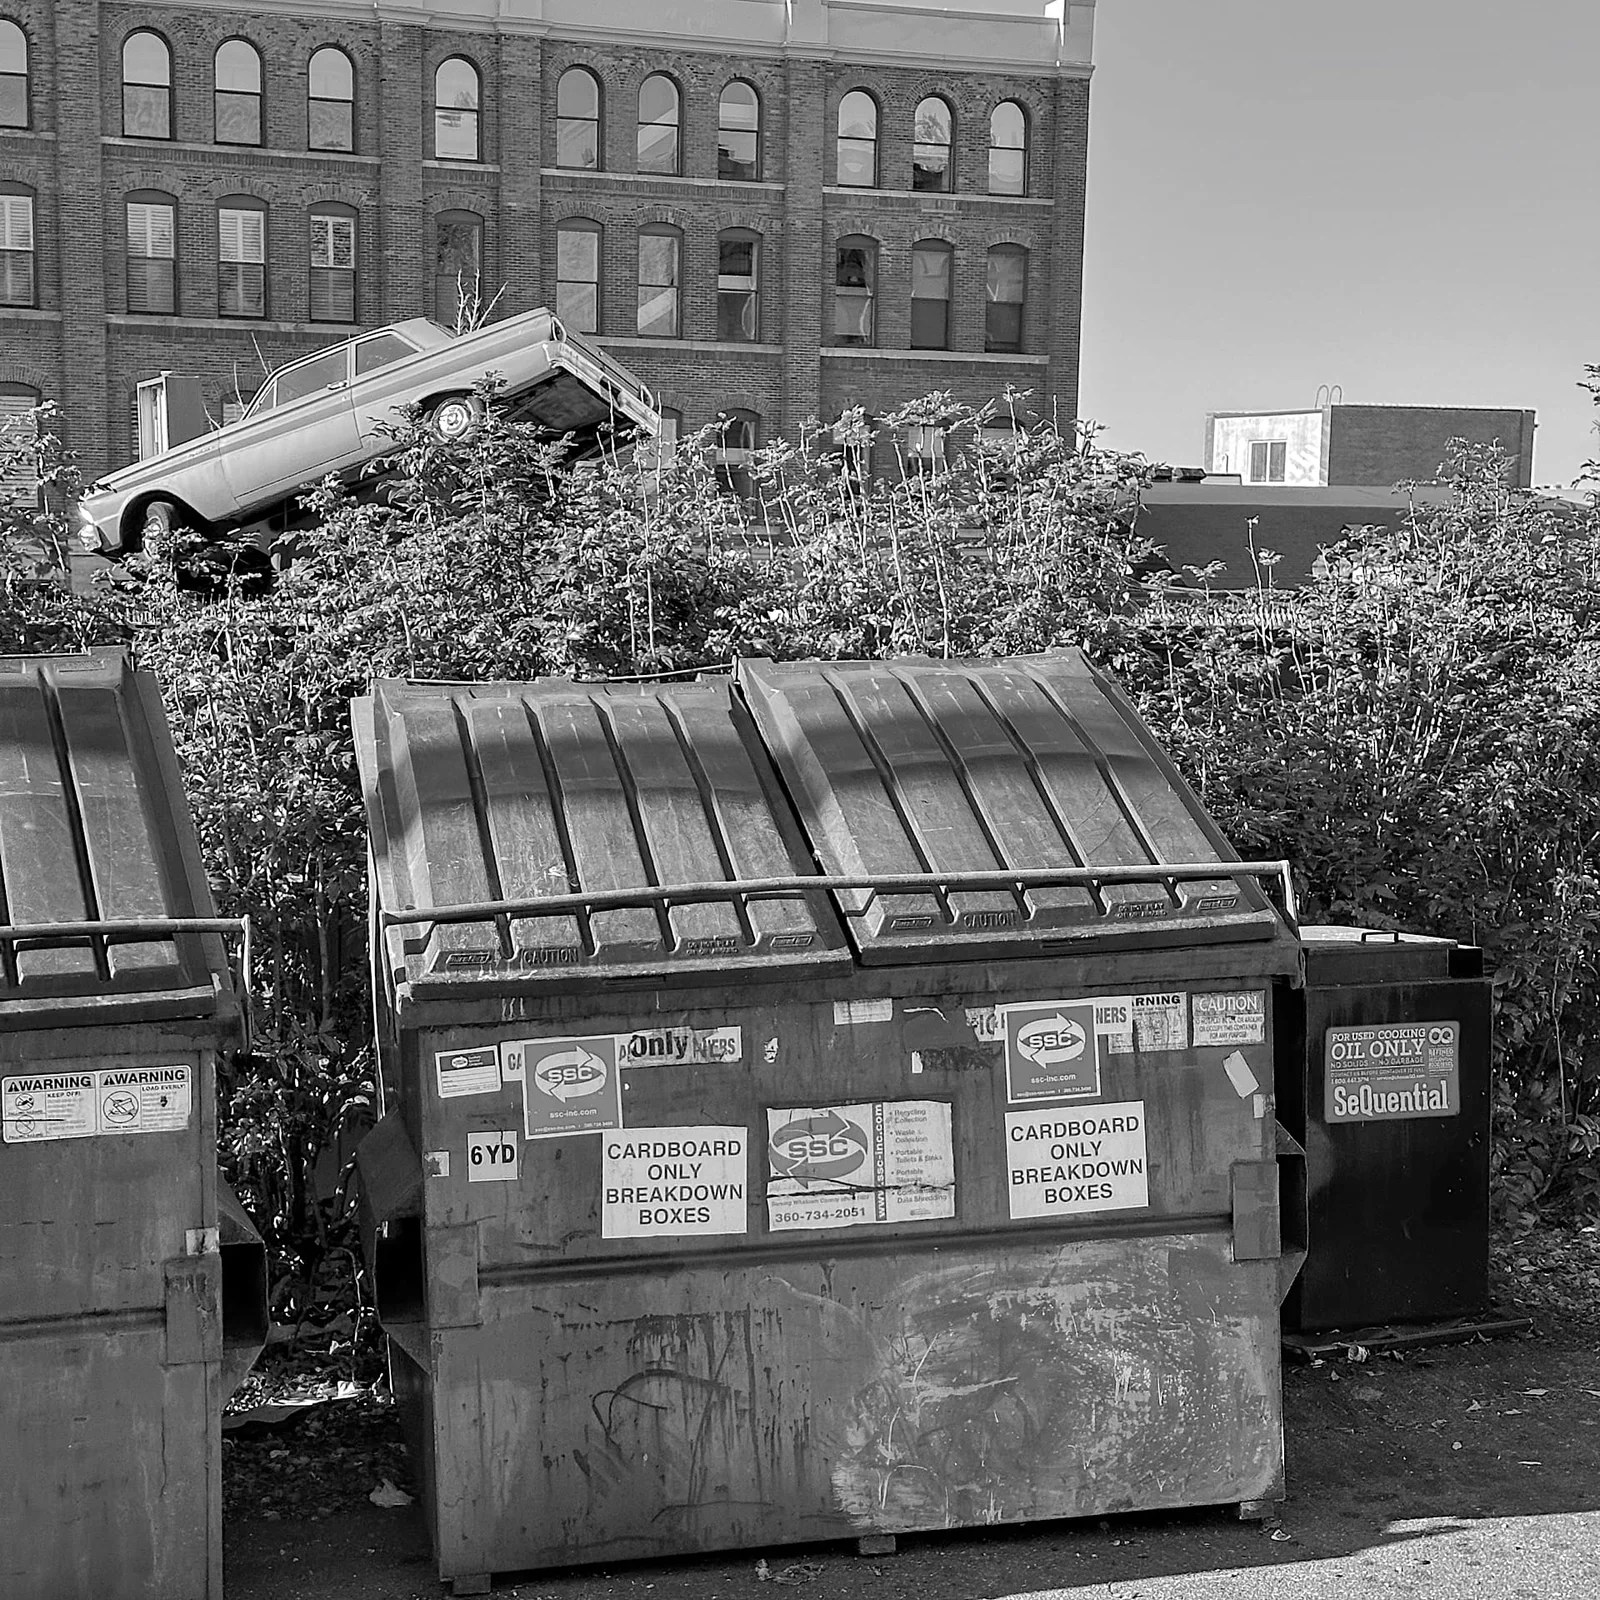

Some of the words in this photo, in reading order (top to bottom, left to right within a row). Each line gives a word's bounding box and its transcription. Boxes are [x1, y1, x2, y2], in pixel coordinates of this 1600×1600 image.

[964, 912, 1016, 928] CAUTION
[523, 948, 579, 965] CAUTION
[1132, 995, 1181, 1007] RNING
[1199, 995, 1258, 1011] CAUTION
[1029, 1033, 1072, 1048] SSC
[1331, 1033, 1350, 1042] FOR
[1352, 1031, 1375, 1041] USED
[1378, 1028, 1426, 1040] COOKING
[628, 1031, 689, 1060] Only
[1331, 1042, 1366, 1060] OIL
[1369, 1039, 1426, 1058] ONLY
[1343, 1060, 1369, 1068] SOLIDS
[1379, 1058, 1389, 1066] NO
[1390, 1057, 1424, 1065] GARBAGE
[115, 1070, 185, 1085] WARNING
[547, 1067, 593, 1082] SSC
[18, 1076, 91, 1092] WARNING
[1334, 1080, 1449, 1117] SeQuential
[1010, 1115, 1140, 1142] CARDBOARD
[607, 1140, 742, 1160] CARDBOARD
[788, 1138, 849, 1159] SSC
[1050, 1141, 1102, 1160] ONLY
[649, 1163, 702, 1181] ONLY
[1011, 1158, 1143, 1186] BREAKDOWN
[606, 1184, 743, 1205] BREAKDOWN
[1044, 1183, 1113, 1204] BOXES
[638, 1207, 711, 1226] BOXES
[775, 1207, 866, 1223] 360-734-2051
